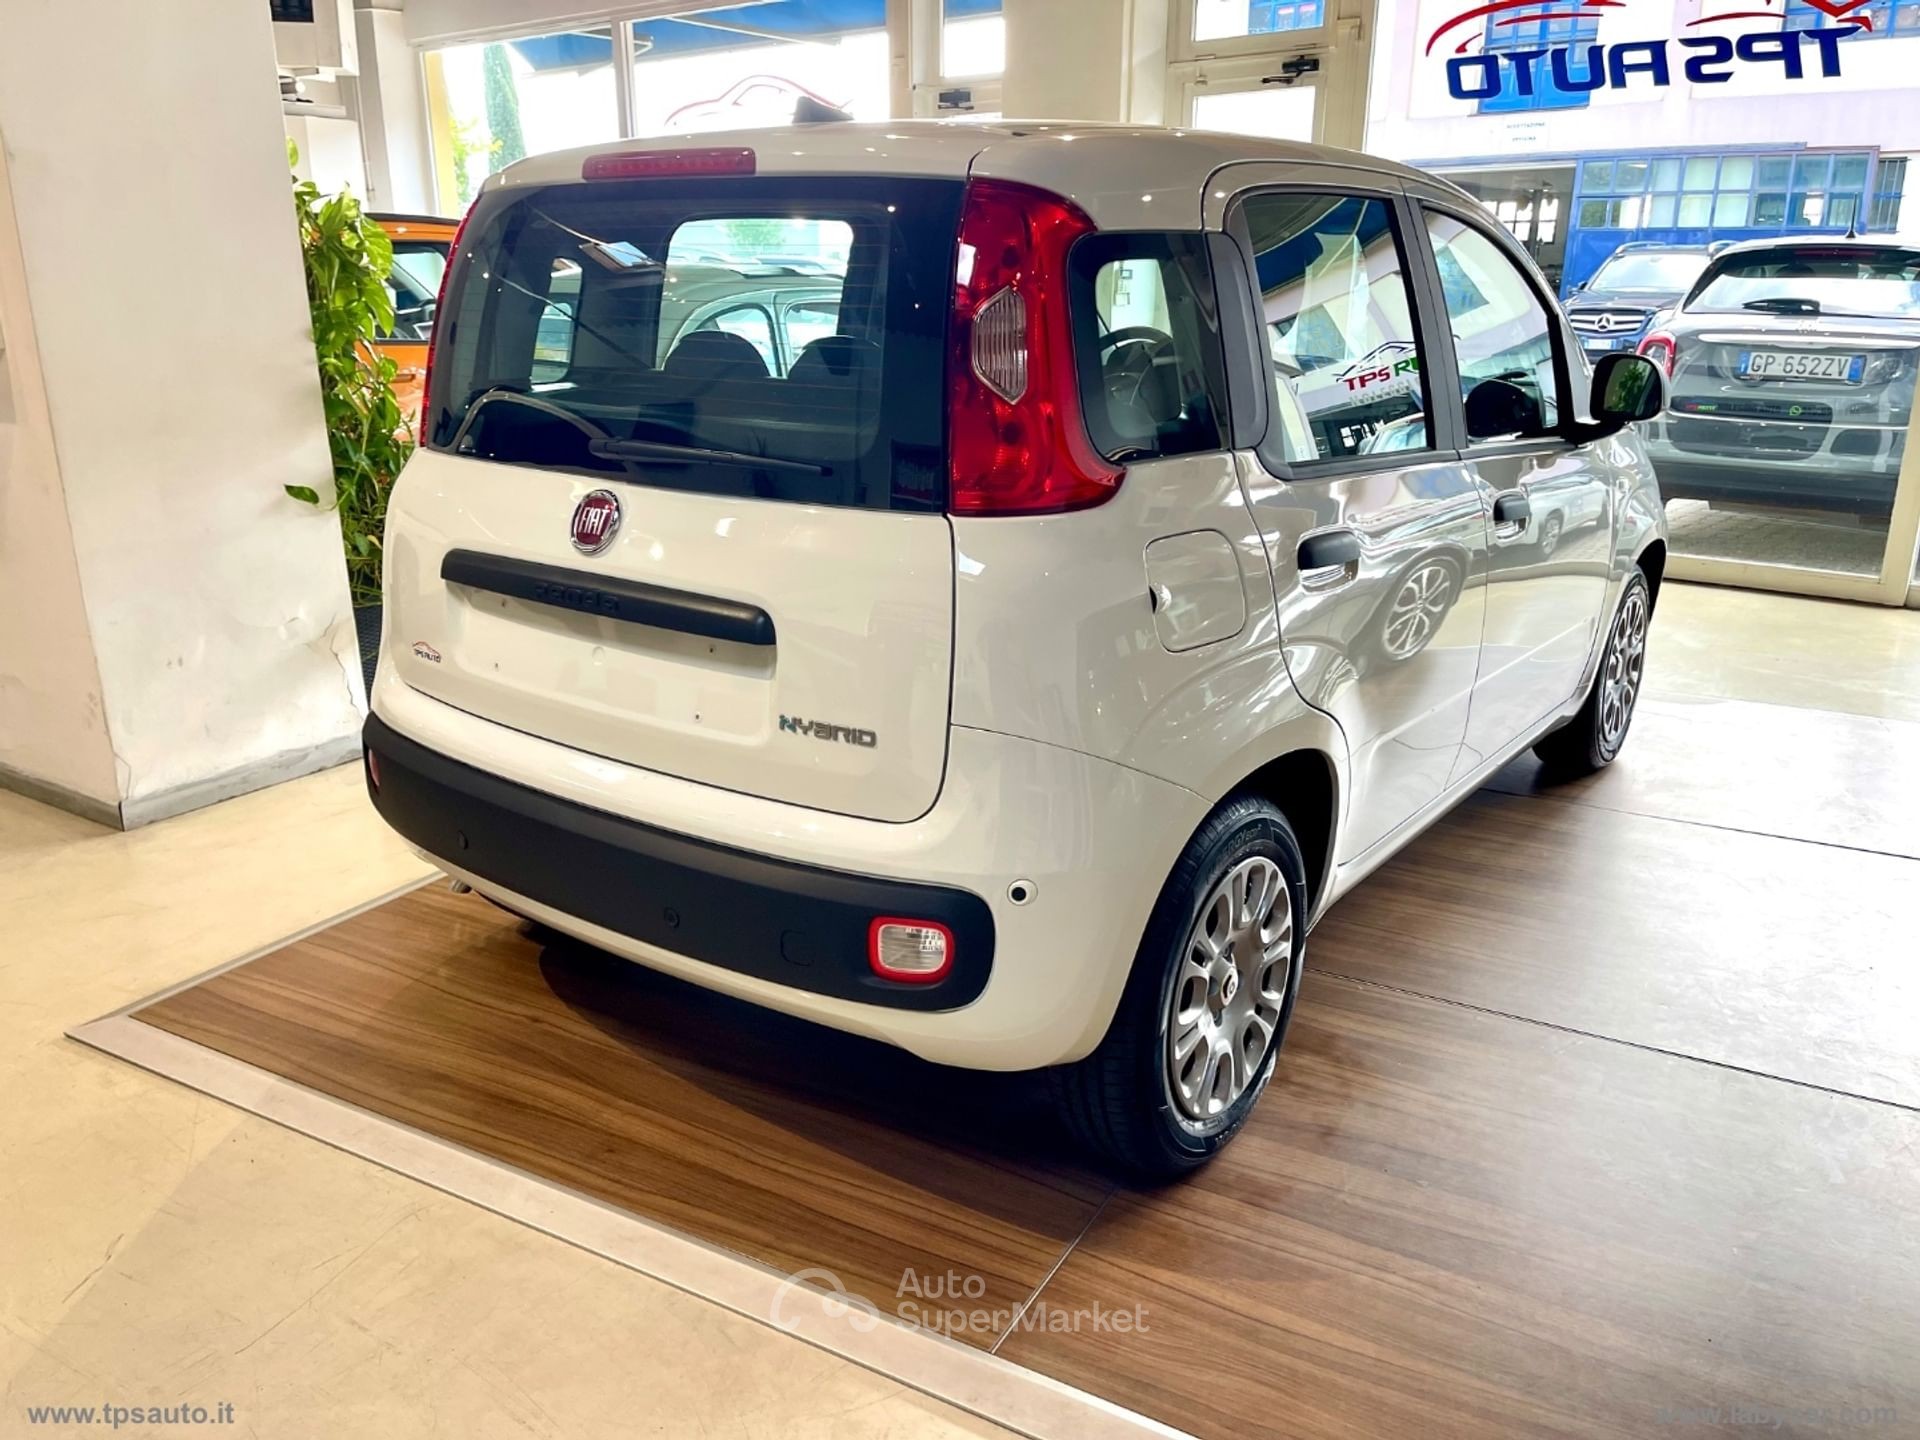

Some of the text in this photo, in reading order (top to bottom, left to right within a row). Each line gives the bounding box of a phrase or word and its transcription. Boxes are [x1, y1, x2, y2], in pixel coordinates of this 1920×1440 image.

[1751, 354, 1848, 377] GP 652ZV
[1342, 366, 1390, 391] TPS
[578, 506, 610, 535] FIAT
